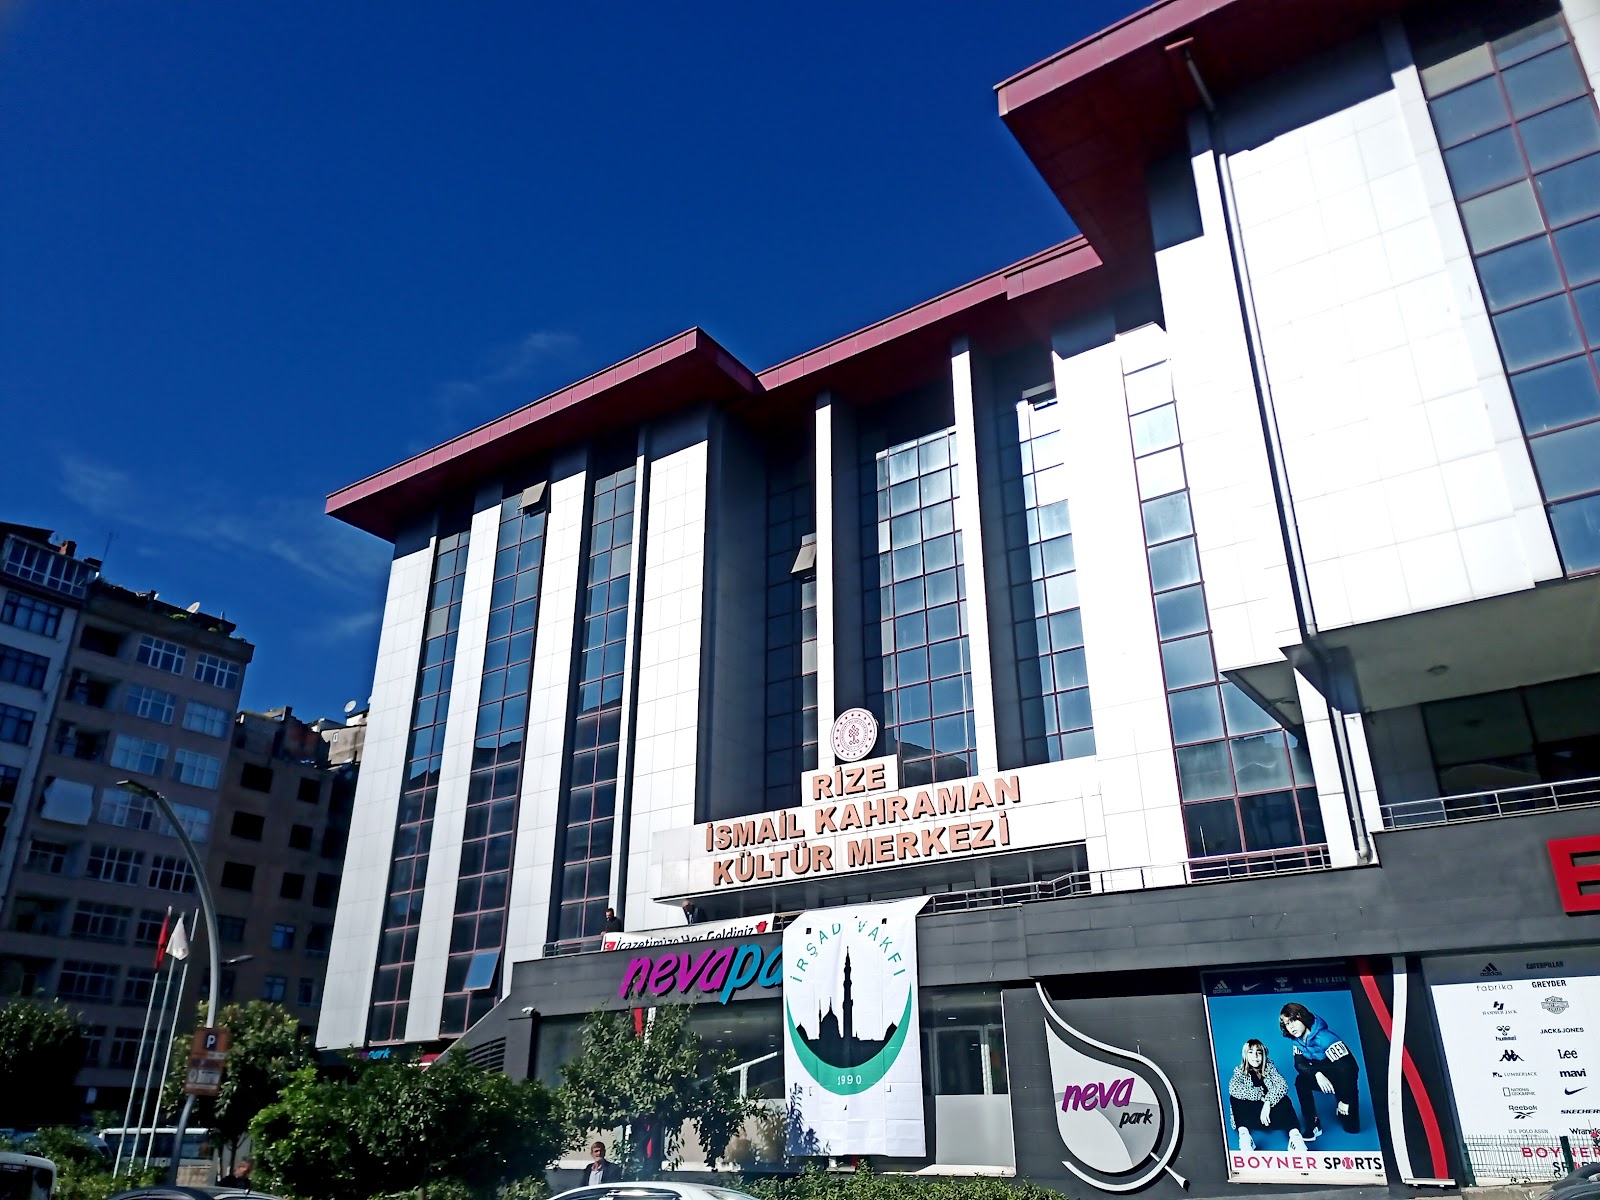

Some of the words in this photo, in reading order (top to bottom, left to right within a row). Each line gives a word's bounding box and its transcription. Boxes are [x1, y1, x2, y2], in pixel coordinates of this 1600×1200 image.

[812, 763, 886, 801] RİZE
[705, 809, 805, 852] İSMAİL
[814, 775, 1021, 835] KAHRAMAN
[712, 839, 833, 886] KÜLTÜR
[847, 810, 1011, 867] MERKEZİ
[857, 920, 906, 977] VAKFI
[1526, 961, 1564, 970] CATERPILLAR
[618, 943, 783, 1005] nevapa
[1476, 983, 1514, 992] fabrika
[1531, 979, 1567, 989] GREYDER
[206, 1034, 216, 1048] P
[1557, 1049, 1578, 1059] Lee
[837, 1074, 862, 1086] 1990
[1559, 1068, 1587, 1078] mavi
[1061, 1077, 1135, 1113] neva
[1119, 1108, 1153, 1129] park
[1233, 1155, 1318, 1170] BOYNER
[1323, 1156, 1383, 1170] SPORTS
